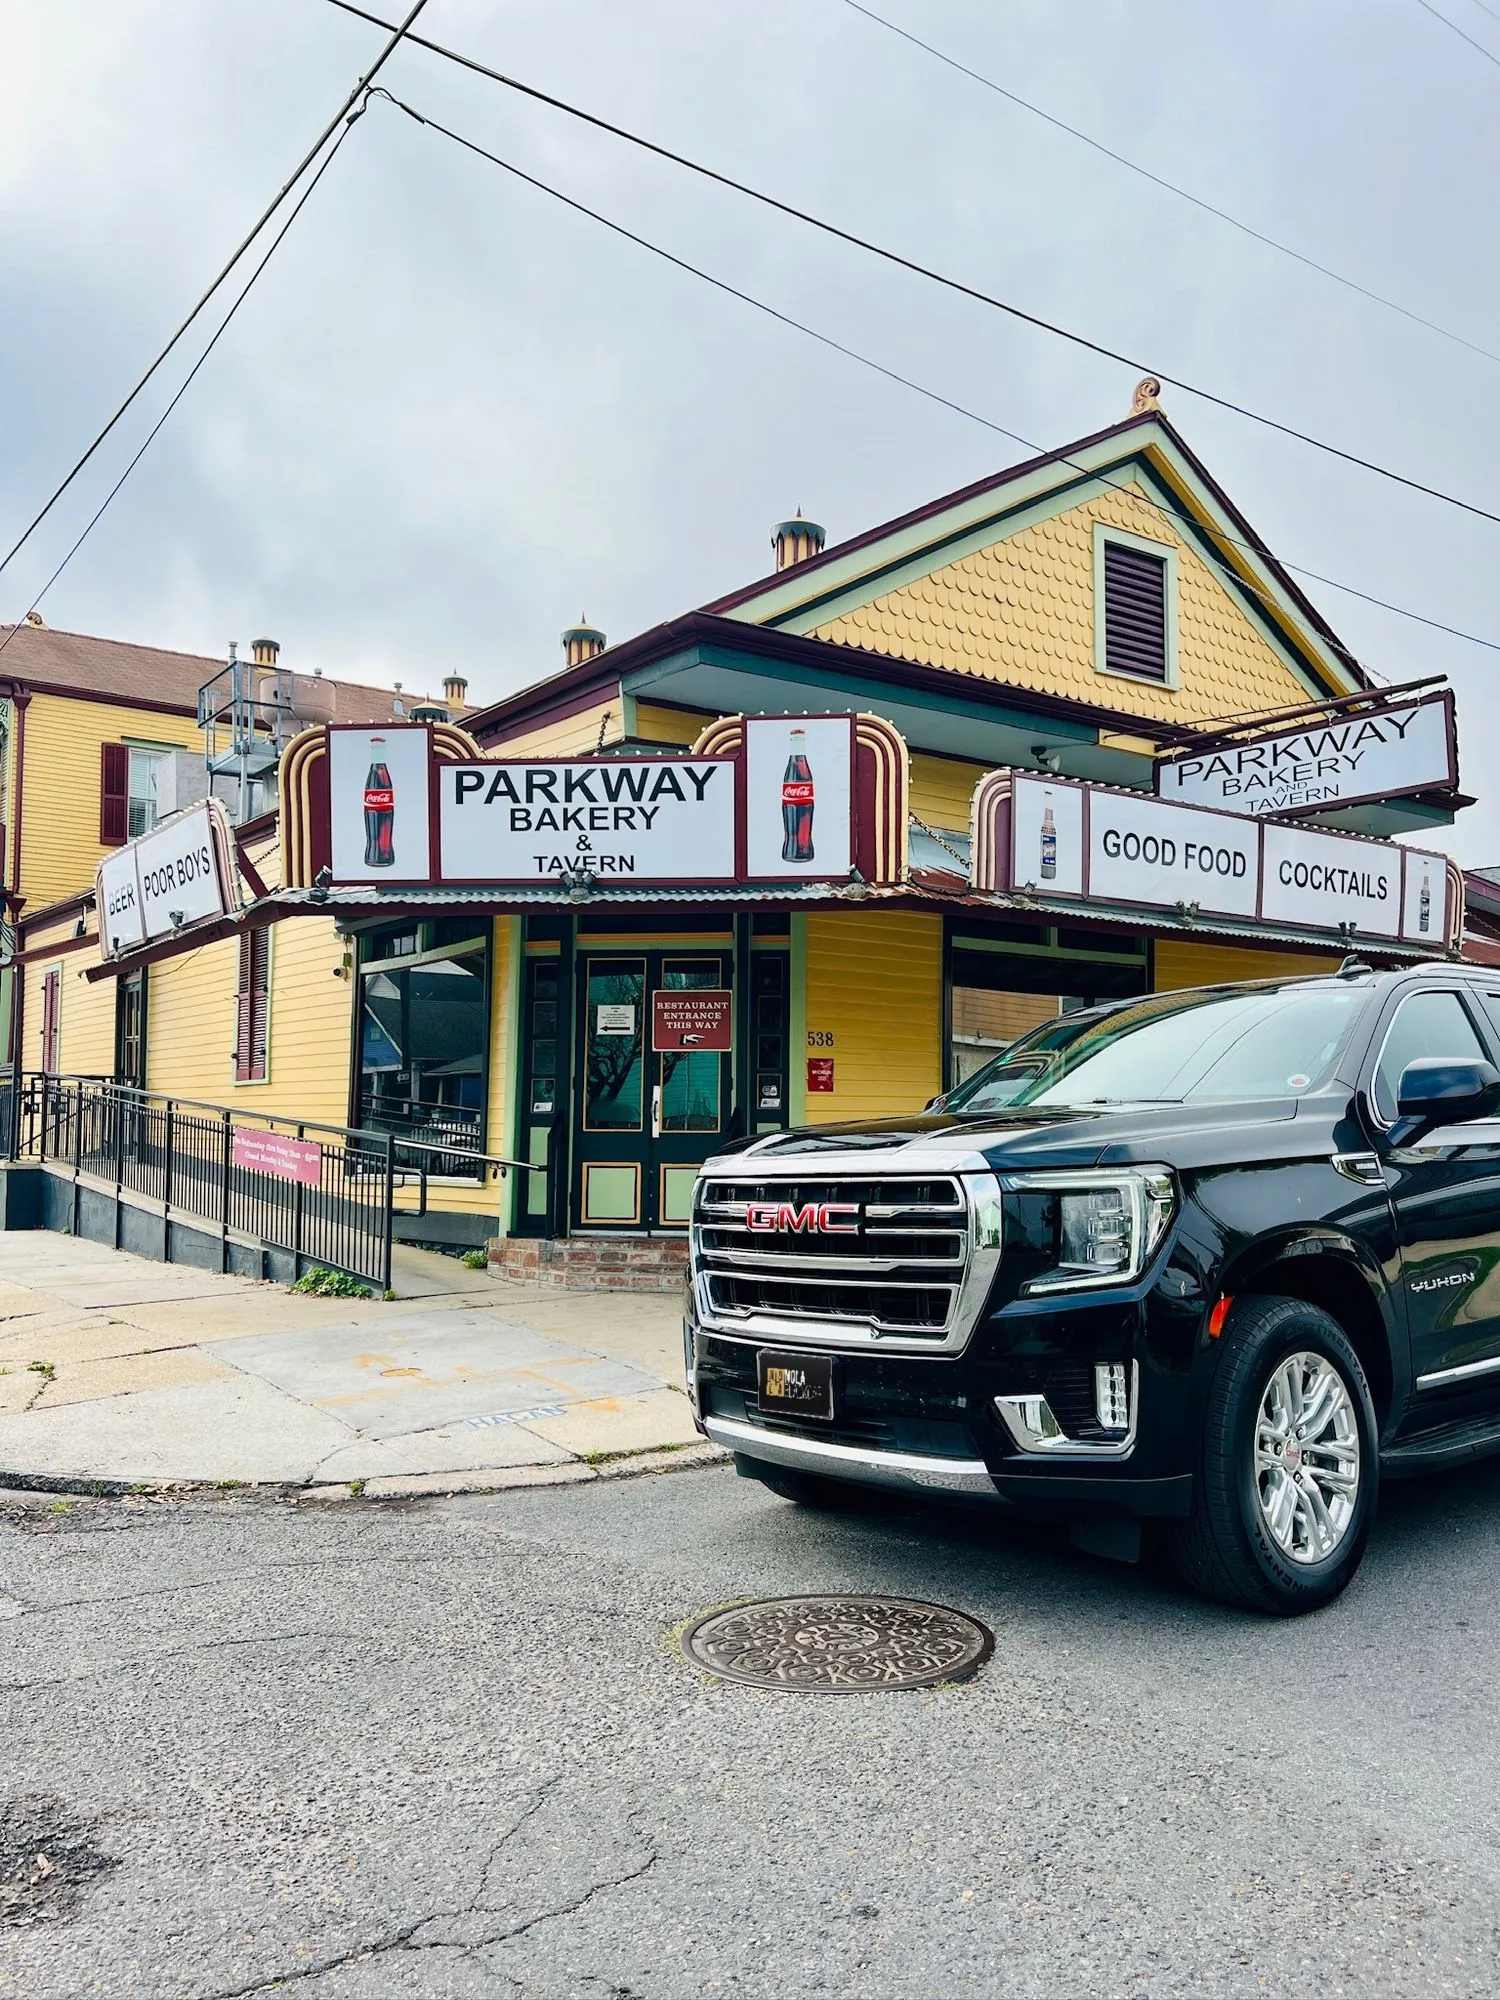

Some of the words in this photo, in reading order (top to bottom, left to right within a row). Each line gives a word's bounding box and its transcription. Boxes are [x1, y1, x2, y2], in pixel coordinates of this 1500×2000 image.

[1177, 710, 1419, 786] PARKWAY
[1222, 751, 1366, 797] BAKERY
[454, 766, 719, 805] PARKWAY
[784, 786, 810, 797] Coca-Cola
[1275, 780, 1309, 794] AND
[366, 793, 390, 803] Coca-Cola
[1245, 784, 1339, 813] TAVERN
[510, 806, 659, 832] BAKERY
[576, 834, 592, 851] &
[1102, 828, 1177, 867] GOOD
[1184, 843, 1247, 878] FOOD
[143, 864, 176, 901] POOR
[177, 847, 210, 886] BOYS
[533, 855, 635, 872] TAVERN
[1278, 859, 1388, 901] COCKTAILS
[108, 883, 136, 916] BEER
[656, 1002, 728, 1010] RESTAURANT
[663, 1012, 722, 1020] ENTRANCE
[666, 1021, 692, 1029] THIS
[695, 1021, 718, 1029] WAY
[807, 1031, 834, 1047] 538
[746, 1203, 859, 1235] GMC
[1410, 1272, 1475, 1293] YUKON
[784, 1368, 805, 1386] NOLA
